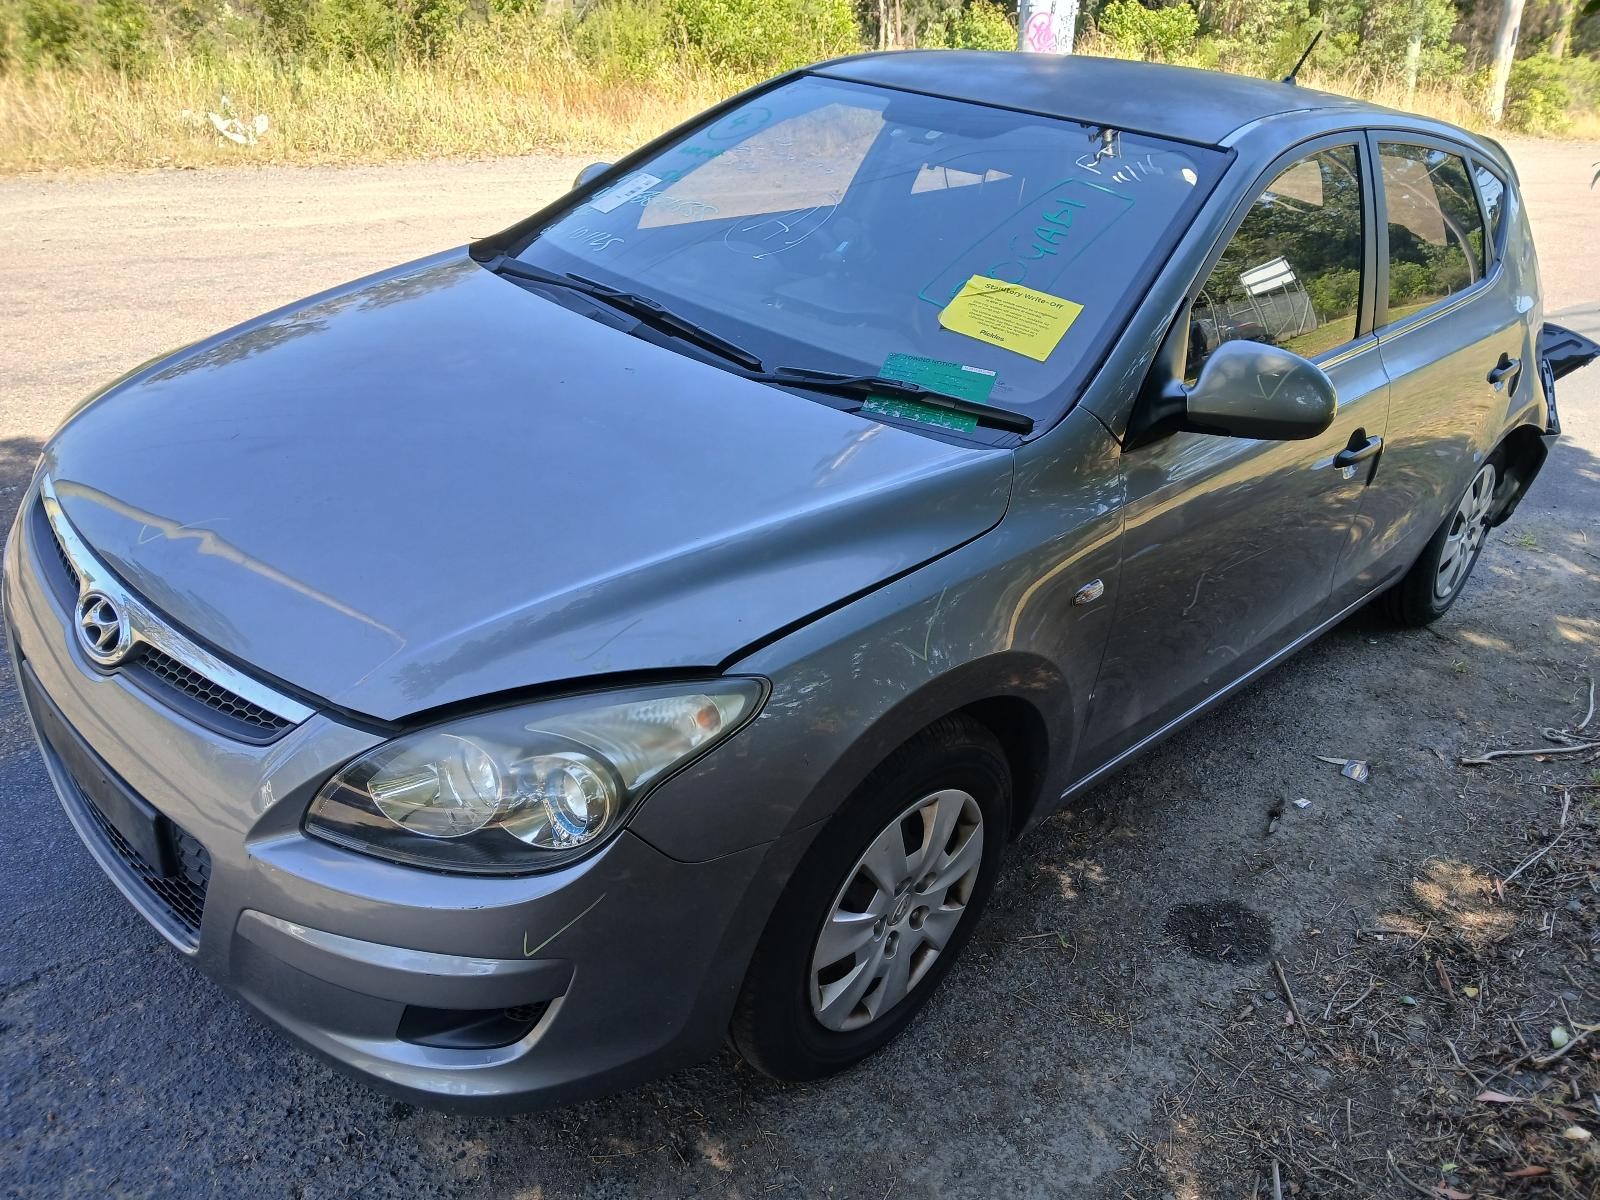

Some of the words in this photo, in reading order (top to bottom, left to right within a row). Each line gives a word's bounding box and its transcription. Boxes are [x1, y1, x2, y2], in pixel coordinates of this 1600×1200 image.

[984, 283, 1024, 298] Statutory
[1024, 293, 1065, 312] Write-Off
[979, 329, 1005, 342] Pickles
